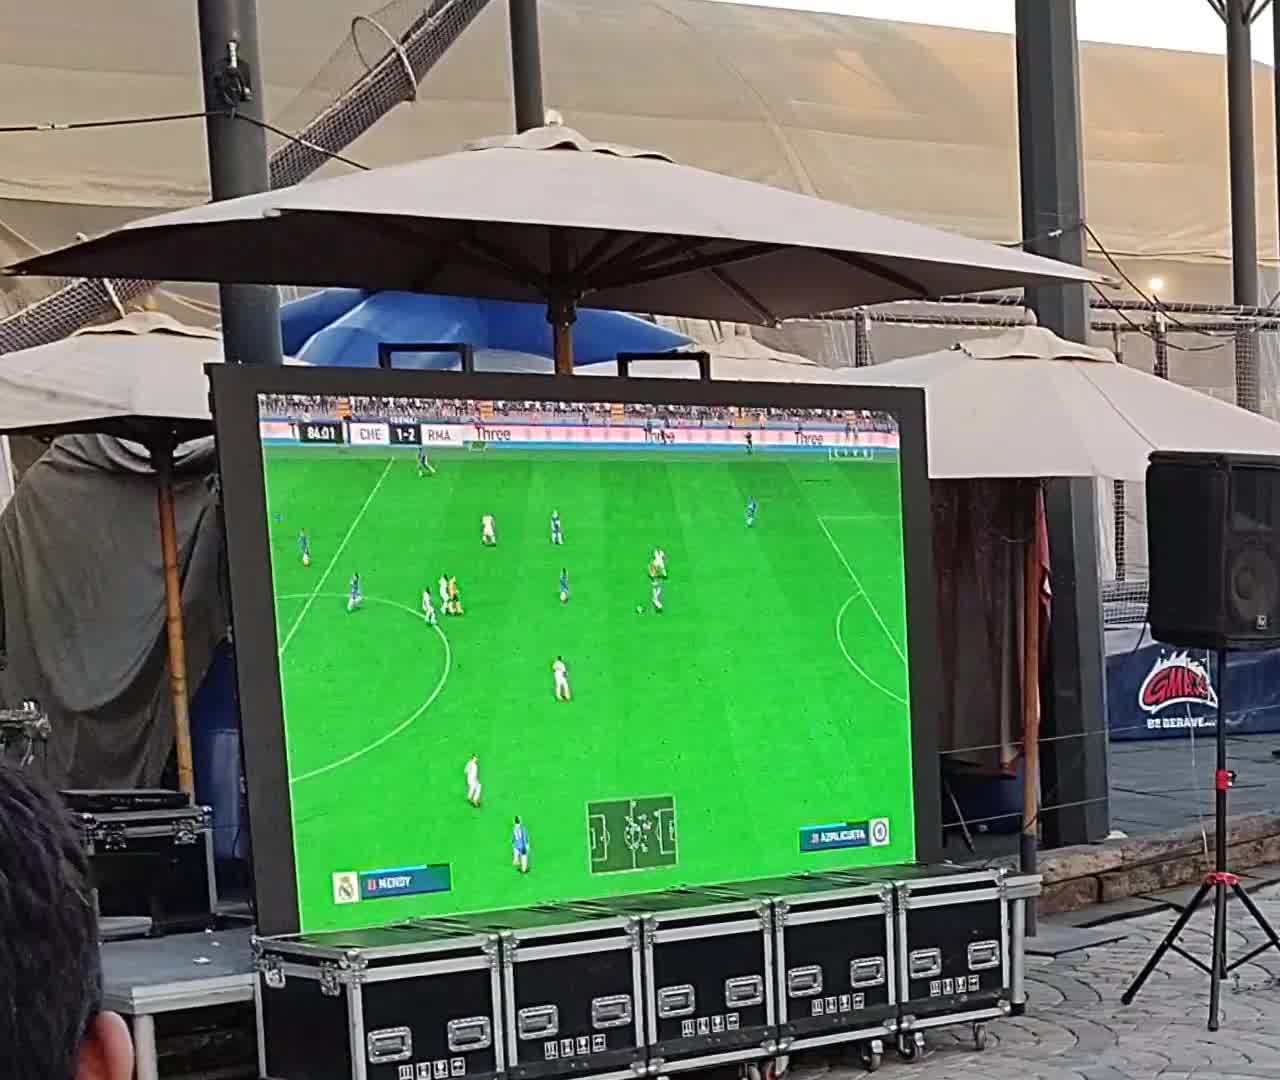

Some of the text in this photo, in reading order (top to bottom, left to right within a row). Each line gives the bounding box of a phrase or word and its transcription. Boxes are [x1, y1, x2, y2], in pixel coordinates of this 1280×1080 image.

[359, 427, 383, 441] CHE
[427, 430, 451, 442] RMA
[474, 427, 512, 442] Three
